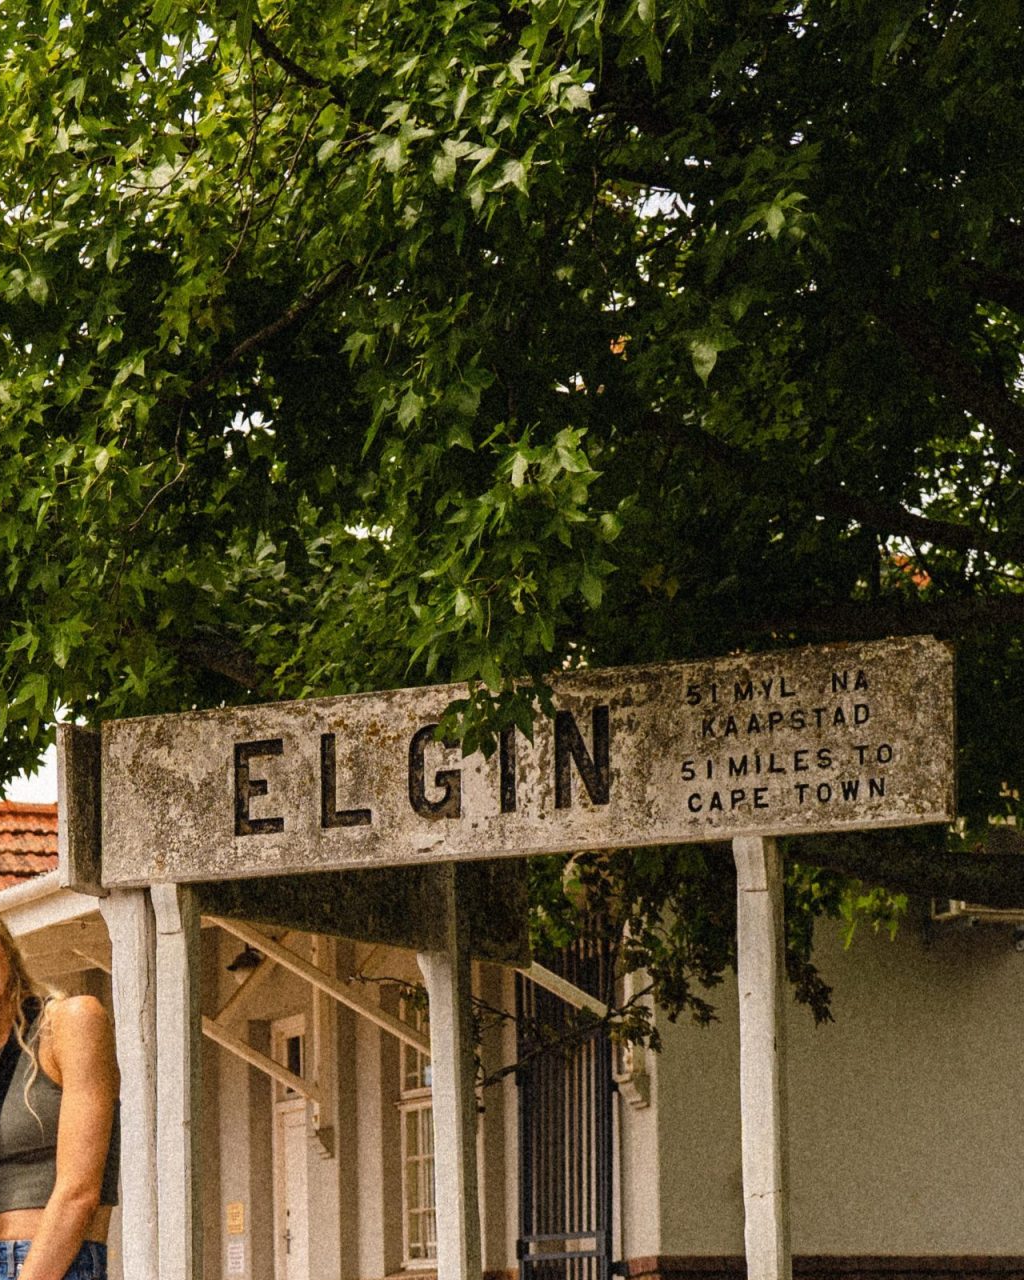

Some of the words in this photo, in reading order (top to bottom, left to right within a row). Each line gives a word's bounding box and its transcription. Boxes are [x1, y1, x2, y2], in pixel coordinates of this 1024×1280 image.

[686, 683, 718, 705] 51
[733, 677, 796, 702] MYL
[831, 670, 869, 693] NA
[701, 703, 871, 737] KAAPSTAD
[233, 705, 610, 837] ELGIN
[681, 759, 713, 781] 51
[728, 748, 833, 777] MILES
[855, 743, 893, 765] TO
[687, 787, 769, 813] CAPE
[795, 777, 886, 804] TOWN
